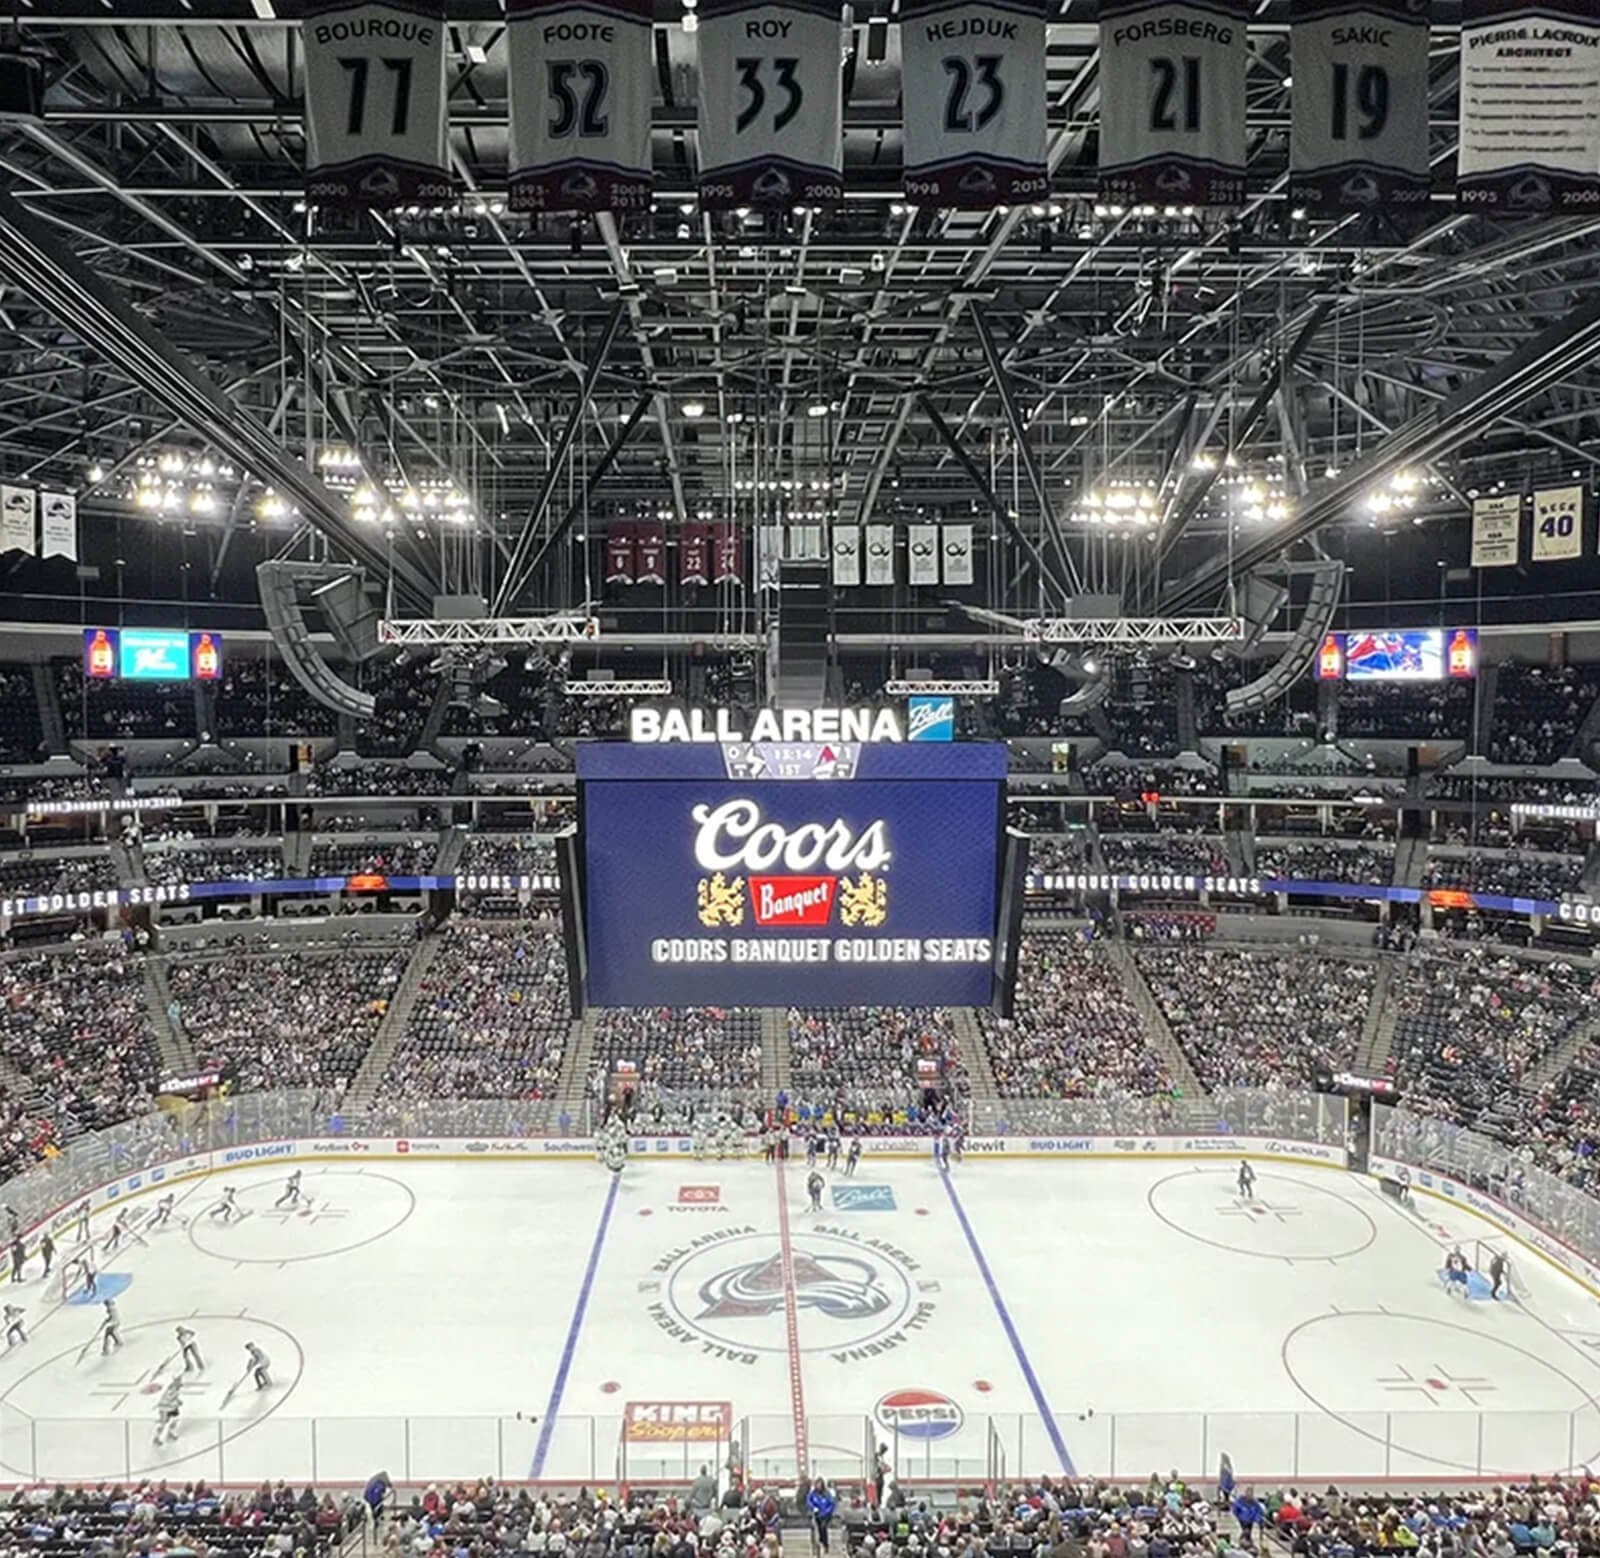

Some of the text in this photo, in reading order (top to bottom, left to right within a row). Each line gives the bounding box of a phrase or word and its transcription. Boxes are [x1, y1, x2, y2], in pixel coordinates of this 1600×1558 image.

[315, 19, 434, 45] BOURQUE
[544, 23, 615, 44] FOOTE
[745, 20, 793, 38] ROY
[926, 18, 1019, 42] HEJDUK
[1114, 18, 1233, 47] FORSBERG
[1331, 28, 1392, 47] SAKIC
[1469, 28, 1599, 49] PIERRE LACROIX
[1496, 48, 1573, 57] ARCHITECT
[337, 56, 413, 136] 77
[546, 58, 609, 139] 52
[736, 57, 803, 135] 33
[940, 55, 1004, 135] 23
[1150, 56, 1200, 133] 21
[1331, 62, 1389, 140] 19
[310, 184, 348, 196] 2000
[701, 185, 734, 198] 1995
[905, 181, 941, 196] 1998
[1011, 180, 1047, 194] 2013
[1461, 190, 1498, 202] 1995
[1539, 515, 1574, 538] 40
[687, 556, 701, 570] 22
[631, 701, 954, 742] BALL ARENA Ball
[779, 764, 801, 775] 1ST
[692, 798, 890, 872] Coors
[455, 875, 511, 890] COORS
[1044, 875, 1119, 890] BANQUET
[1129, 875, 1195, 890] GOLDEN
[1204, 876, 1261, 892] SEATS
[38, 890, 119, 912] GOLDEN
[129, 884, 191, 904] SEATS
[759, 881, 829, 921] Banquet
[652, 938, 992, 963] COORS BANQUET GOLDEN SEATS
[226, 1144, 292, 1161] BUD LIGHT
[1030, 1140, 1091, 1150] BUD LIGHT
[653, 1225, 758, 1273] BALL ARENA
[812, 1224, 921, 1272] BALL ARENA
[647, 1303, 759, 1366] BALL ARENA
[831, 1301, 937, 1365] BALL ARENA
[632, 1404, 724, 1423] KING
[880, 1406, 958, 1421] PEPSI
